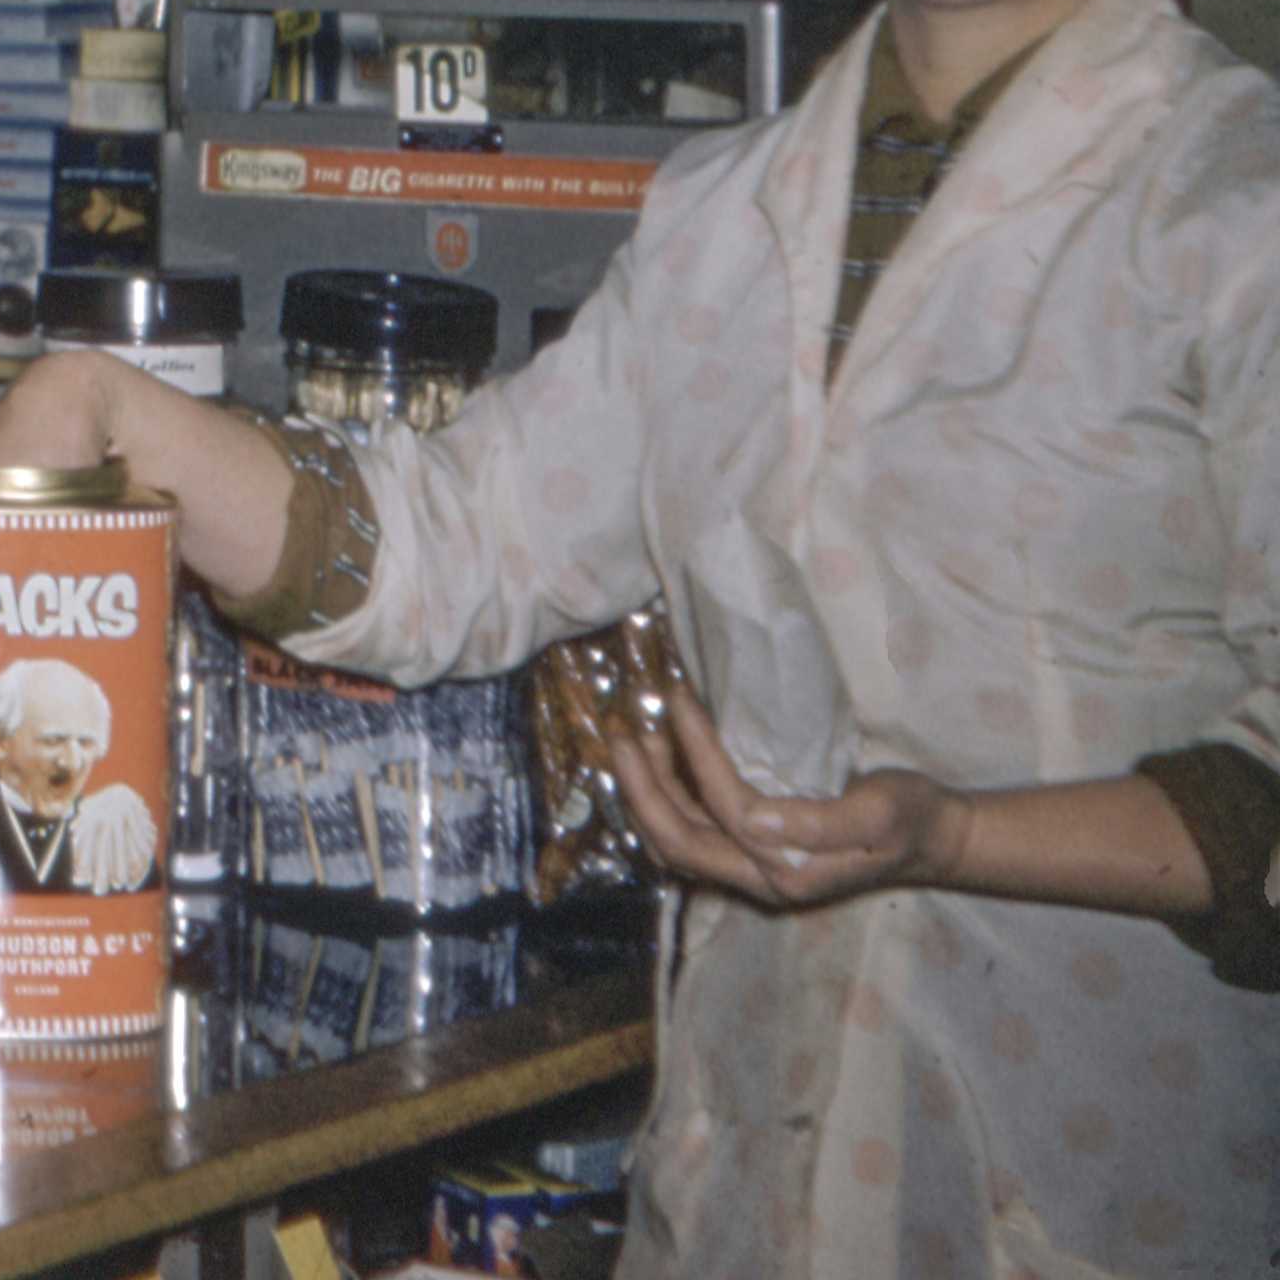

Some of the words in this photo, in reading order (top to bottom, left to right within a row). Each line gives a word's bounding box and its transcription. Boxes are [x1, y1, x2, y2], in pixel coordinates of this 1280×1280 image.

[222, 154, 303, 188] Kingsway
[312, 168, 342, 183] THE
[348, 166, 402, 193] BIG
[407, 172, 496, 192] CIGARETTE
[501, 176, 545, 193] WITH
[550, 177, 583, 195] THE
[83, 934, 100, 956] &
